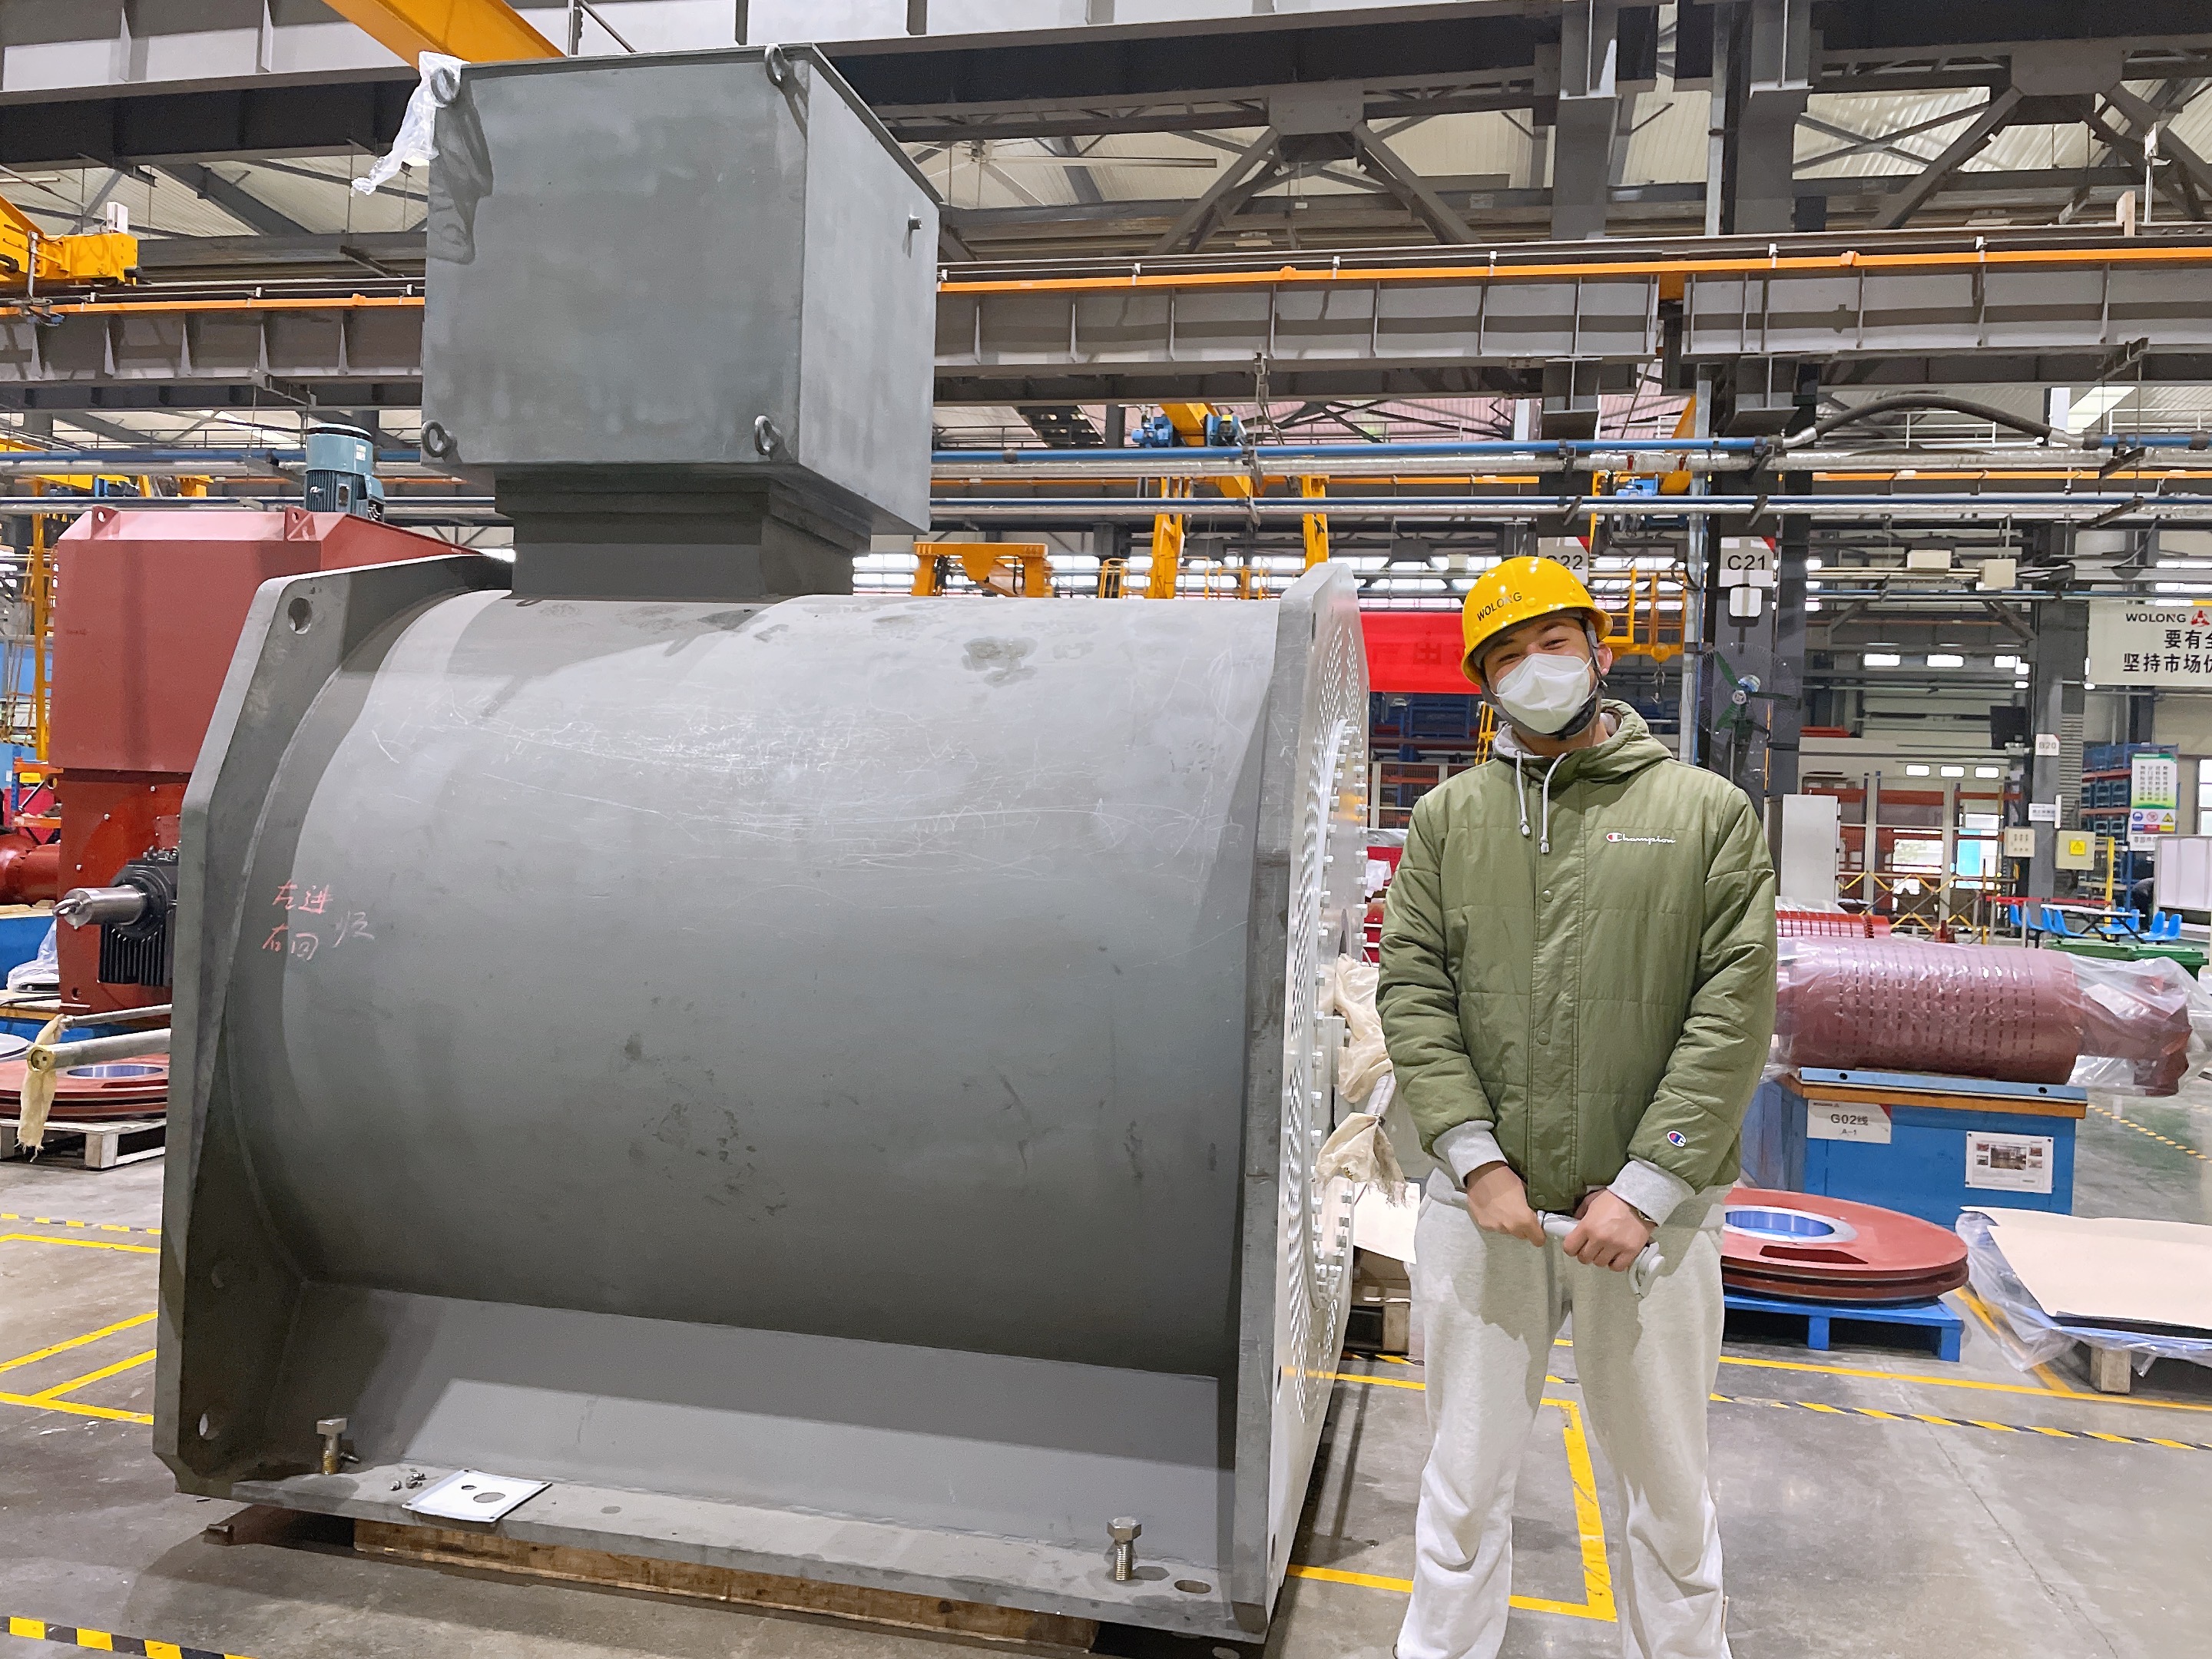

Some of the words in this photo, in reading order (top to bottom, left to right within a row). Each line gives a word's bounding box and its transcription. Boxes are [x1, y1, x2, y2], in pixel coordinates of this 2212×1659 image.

[1727, 555, 1765, 570] C21
[1477, 592, 1522, 621] WOLONG
[2126, 613, 2186, 623] WOLONG
[1606, 832, 1677, 846] Champion
